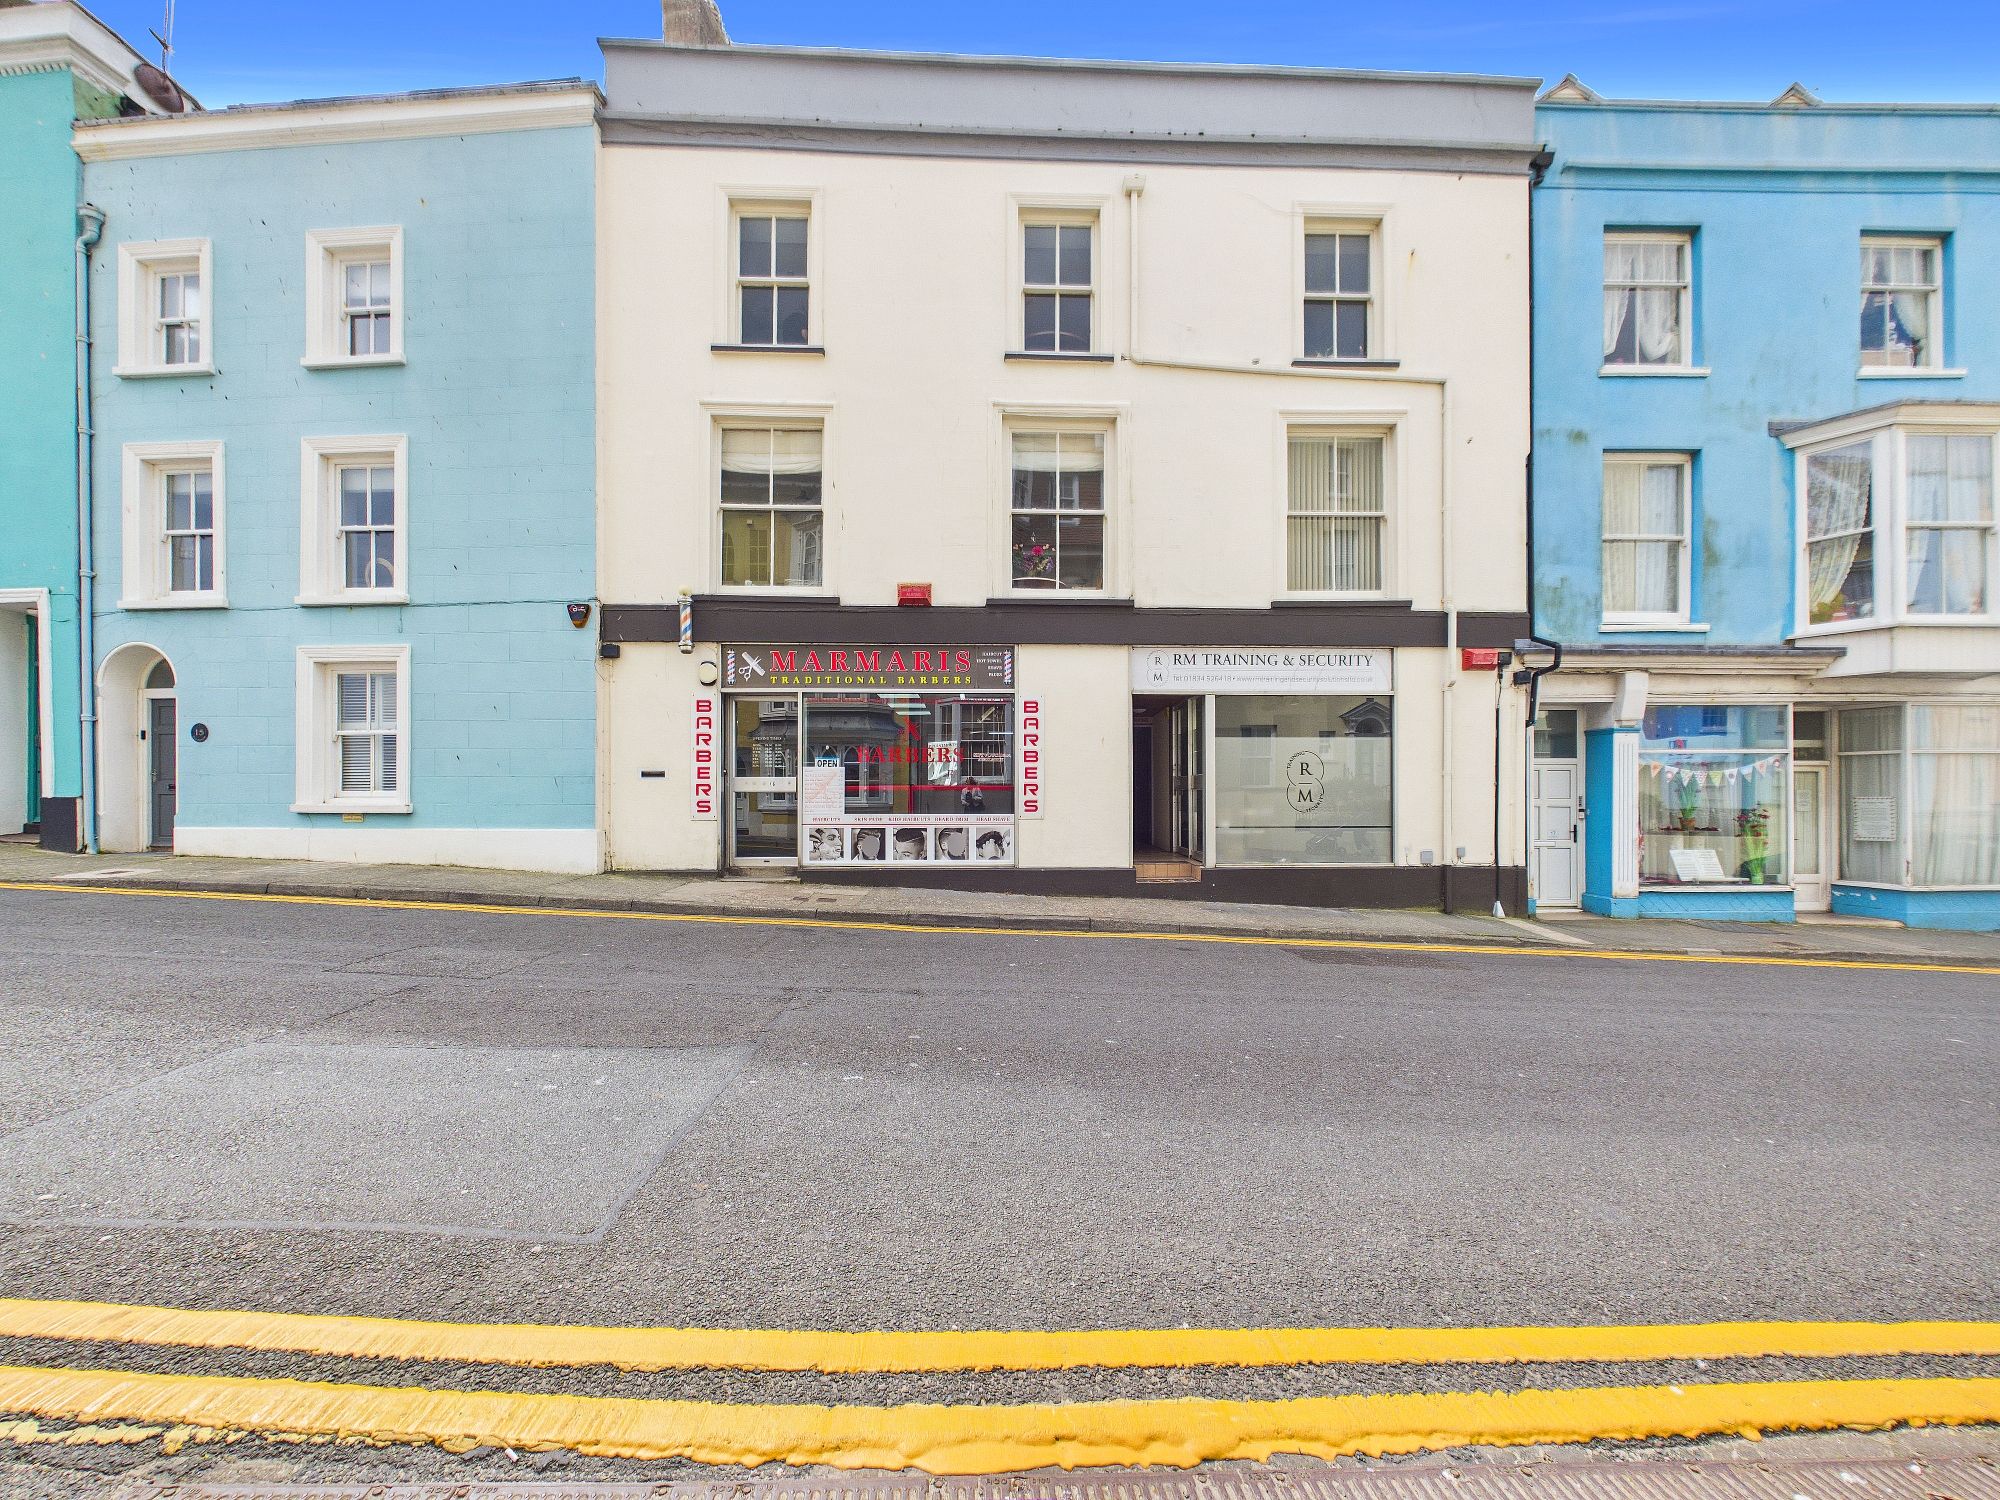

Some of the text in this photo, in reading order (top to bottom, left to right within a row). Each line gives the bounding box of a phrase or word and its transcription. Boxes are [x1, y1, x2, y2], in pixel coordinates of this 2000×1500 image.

[769, 650, 972, 673] MARMARIS
[1155, 656, 1162, 666] R
[1173, 654, 1373, 666] RM TRAINING & SECURITY
[770, 676, 972, 685] TRADITIONAL BARBERS
[1153, 673, 1163, 682] M
[695, 699, 712, 813] BARBERS
[856, 746, 964, 763] BARBERS
[1023, 700, 1039, 813] BARBERS
[816, 760, 838, 768] OPEN
[1299, 762, 1314, 776] R
[1297, 789, 1314, 803] M
